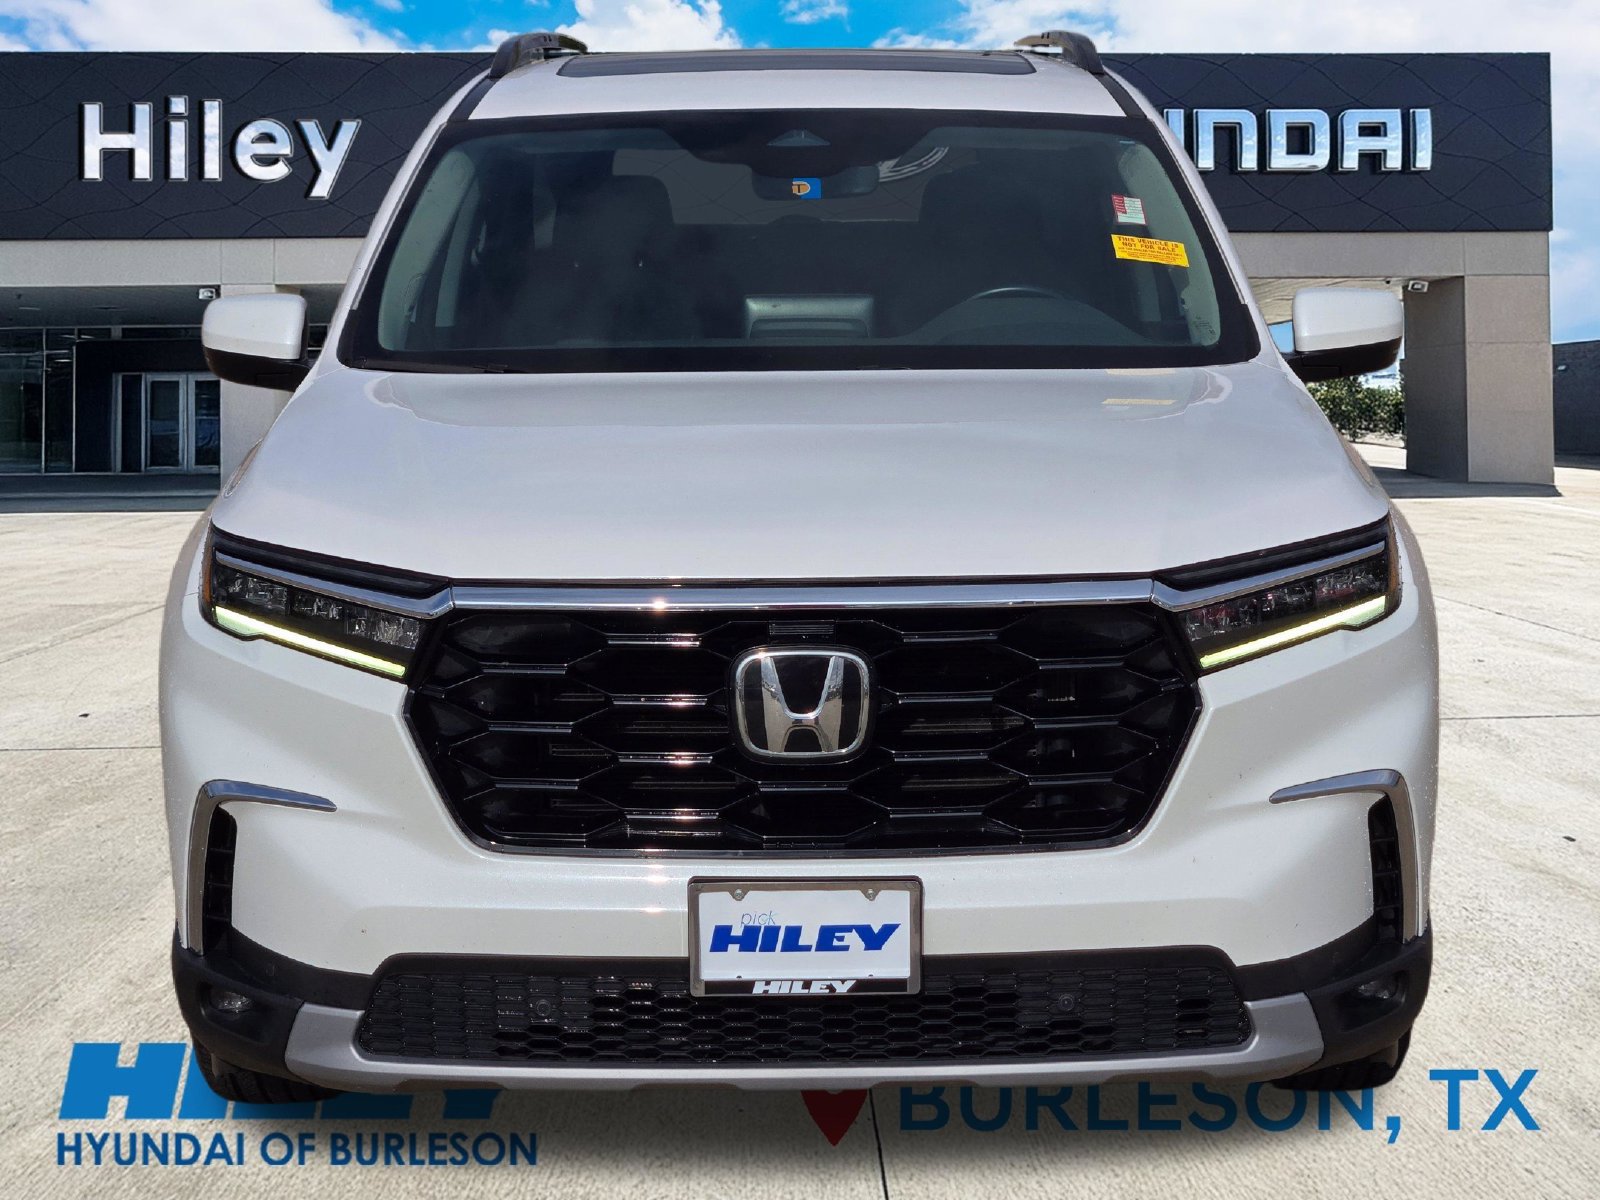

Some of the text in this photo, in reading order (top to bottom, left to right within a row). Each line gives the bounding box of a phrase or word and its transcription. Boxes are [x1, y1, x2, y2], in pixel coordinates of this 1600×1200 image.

[80, 95, 362, 199] Hiley
[1163, 108, 1433, 171] NDAI
[1137, 238, 1168, 247] VEHICLE
[741, 911, 777, 927] pick
[709, 923, 901, 952] HILEY
[752, 980, 856, 994] HILEY
